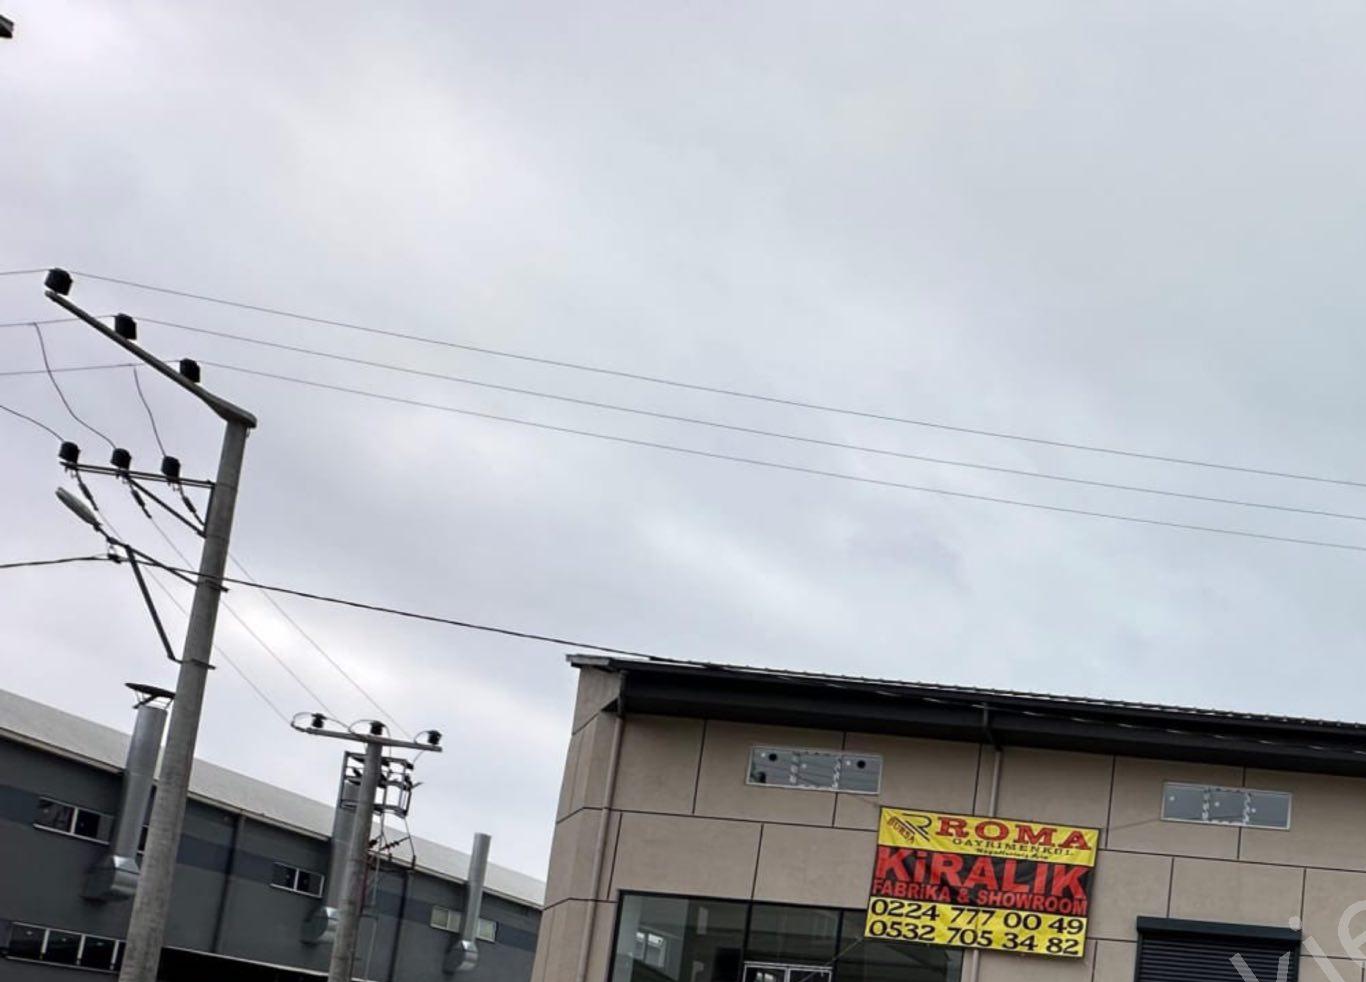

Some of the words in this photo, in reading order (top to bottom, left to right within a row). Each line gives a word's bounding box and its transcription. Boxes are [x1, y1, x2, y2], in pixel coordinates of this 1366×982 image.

[935, 816, 1091, 850] ROMA
[871, 899, 940, 921] 0224
[950, 907, 996, 926] 777
[1003, 912, 1042, 931] 00
[1048, 917, 1084, 935] 49
[956, 888, 971, 903] &
[976, 891, 1087, 915] SHOWROOM
[868, 920, 936, 941] 0532
[947, 927, 993, 947] 705
[1003, 932, 1038, 951] 34
[1046, 937, 1079, 956] 82
